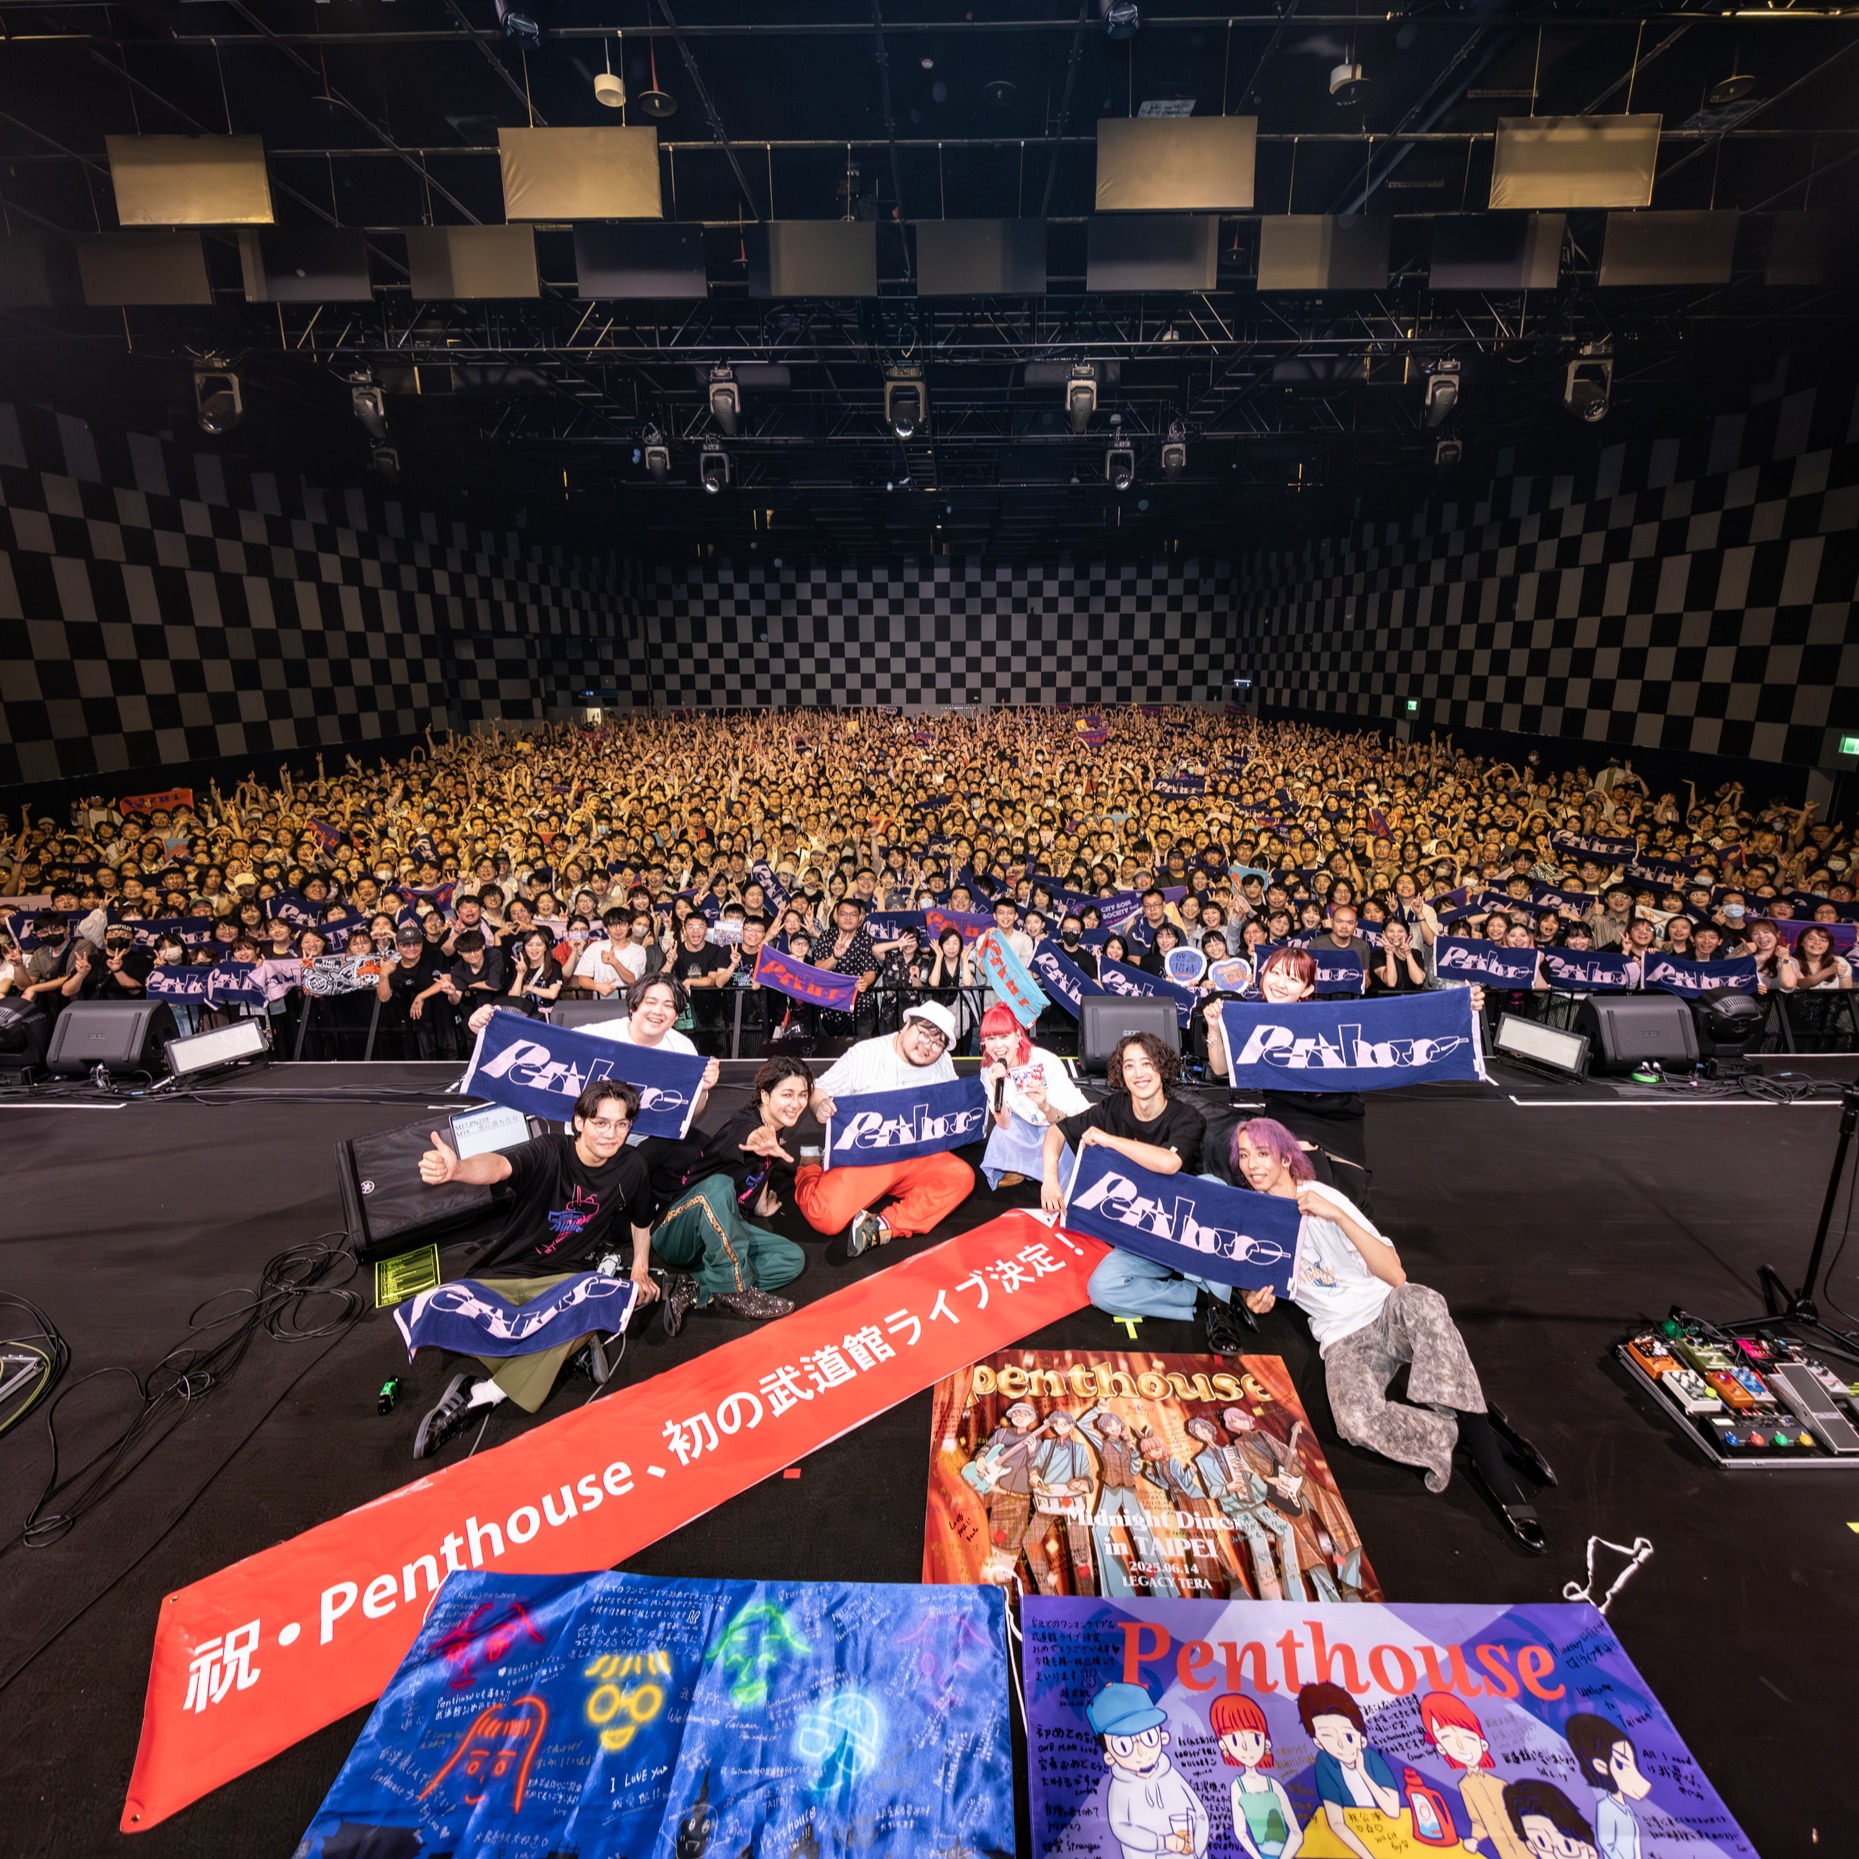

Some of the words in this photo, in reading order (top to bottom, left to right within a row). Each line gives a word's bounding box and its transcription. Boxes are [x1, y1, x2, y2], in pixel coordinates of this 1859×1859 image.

[1236, 1023, 1469, 1069] Penthouse
[833, 1103, 985, 1150] Penthouse
[1072, 1170, 1292, 1267] Penthouse
[1066, 1507, 1171, 1537] Midnight
[1103, 1535, 1128, 1556] in
[1133, 1537, 1220, 1559] TAIPEI
[1128, 1560, 1200, 1575] 2025.06.14
[1121, 1574, 1177, 1589] LEGACY
[1178, 1579, 1213, 1591] TERA
[1117, 1619, 1566, 1701] Penthouse
[1037, 1742, 1055, 1753] ONE
[1058, 1743, 1079, 1753] MAN
[609, 1776, 616, 1794] I
